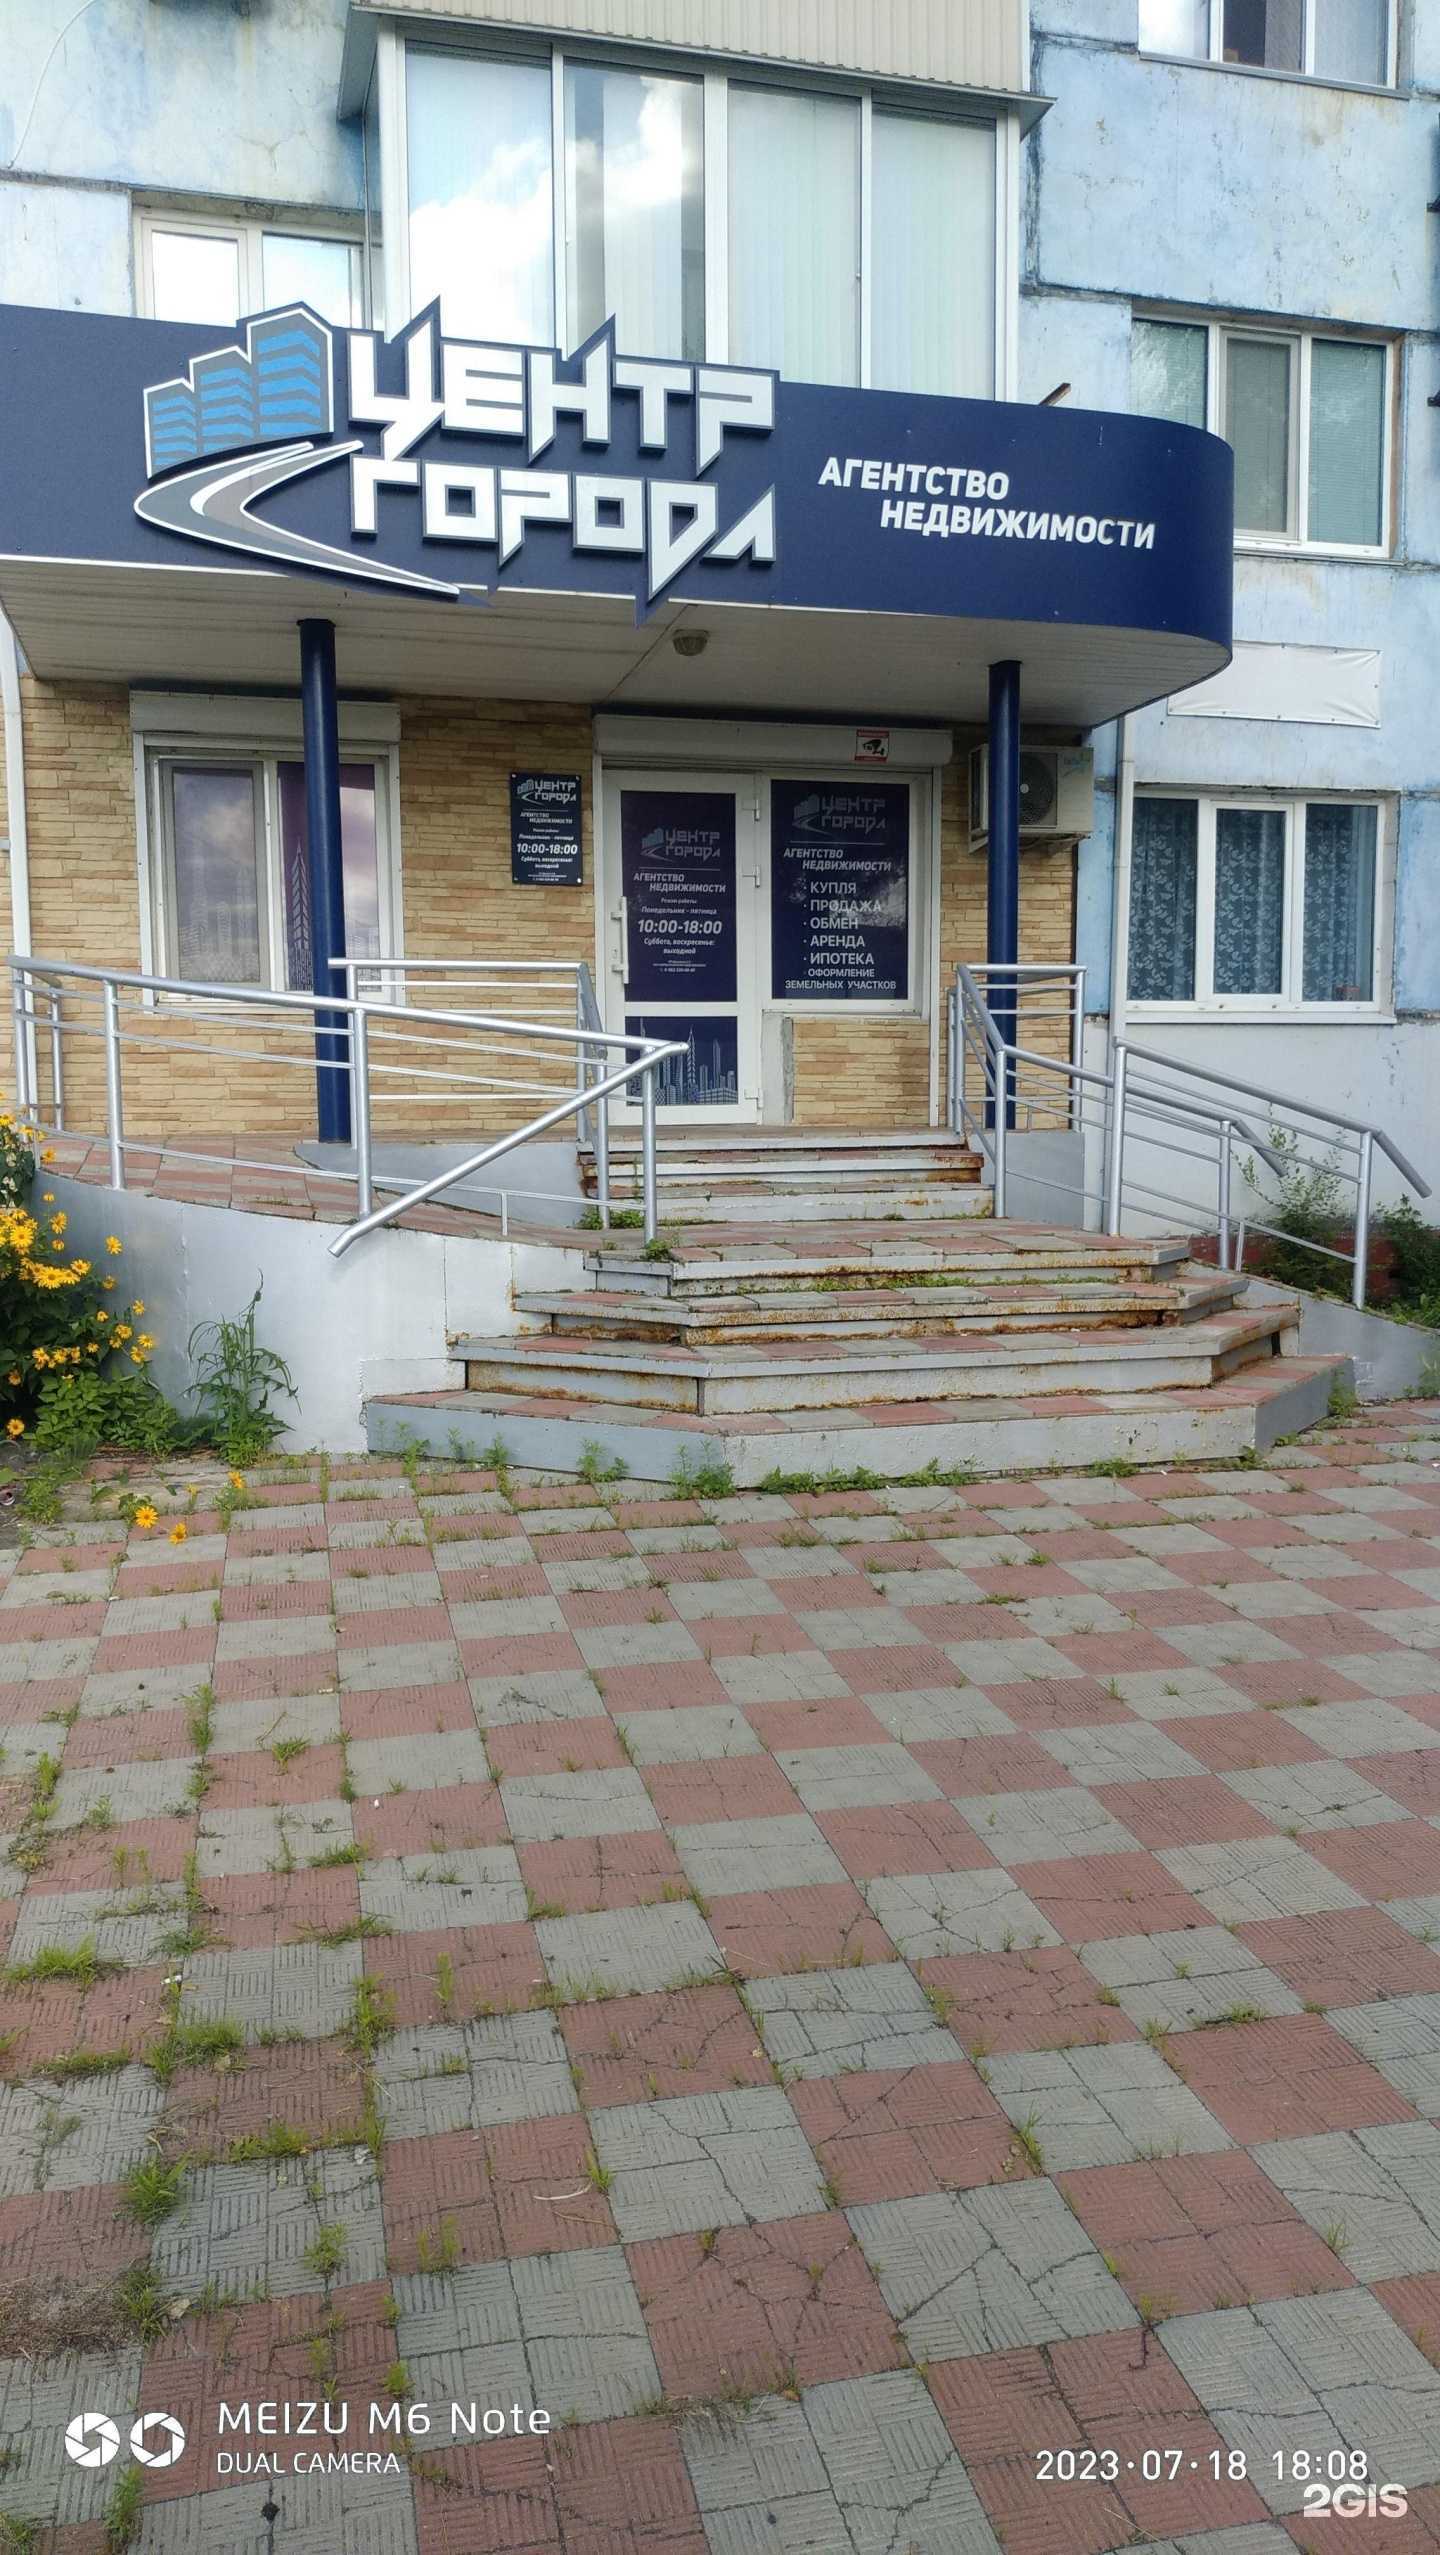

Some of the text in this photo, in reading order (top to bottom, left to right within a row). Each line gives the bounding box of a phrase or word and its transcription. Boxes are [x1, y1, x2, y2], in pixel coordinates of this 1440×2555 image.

[347, 318, 776, 478] ЦЕНТР
[818, 456, 1010, 501] АГЕНТСТВО
[350, 454, 776, 601] ГОРОДА
[880, 499, 1156, 550] НЕДВИЖИМОСТИ
[534, 780, 576, 792] ЦЕНТР
[534, 791, 577, 804] ГОРОДА
[821, 795, 886, 815] ЦЕНТР
[821, 814, 886, 834] ГОРОДА
[665, 828, 721, 846] ЦЕНТР
[516, 843, 578, 855] 10:00-18:00
[665, 844, 721, 862] ГОРОДА
[783, 848, 844, 859] АГЕНТСТВО
[802, 860, 892, 872] НЕДВИЖИМОСТИ
[633, 872, 685, 882] АГЕНТСТВО
[649, 883, 727, 893] НЕДВИЖИМОСТИ
[810, 882, 857, 894] КУПЛЯ
[810, 900, 882, 914] ПРОДАЖА
[637, 919, 723, 935] 10:00-18:00
[810, 917, 859, 930] ОБМЕН
[810, 935, 865, 949] АРЕНДА
[810, 953, 875, 965] ИПОТЕКА
[807, 968, 875, 977] ОФОРМЛЕНИЕ
[785, 980, 897, 990] ЗЕМЕЛЬНЫХ УЧАСТКОВ
